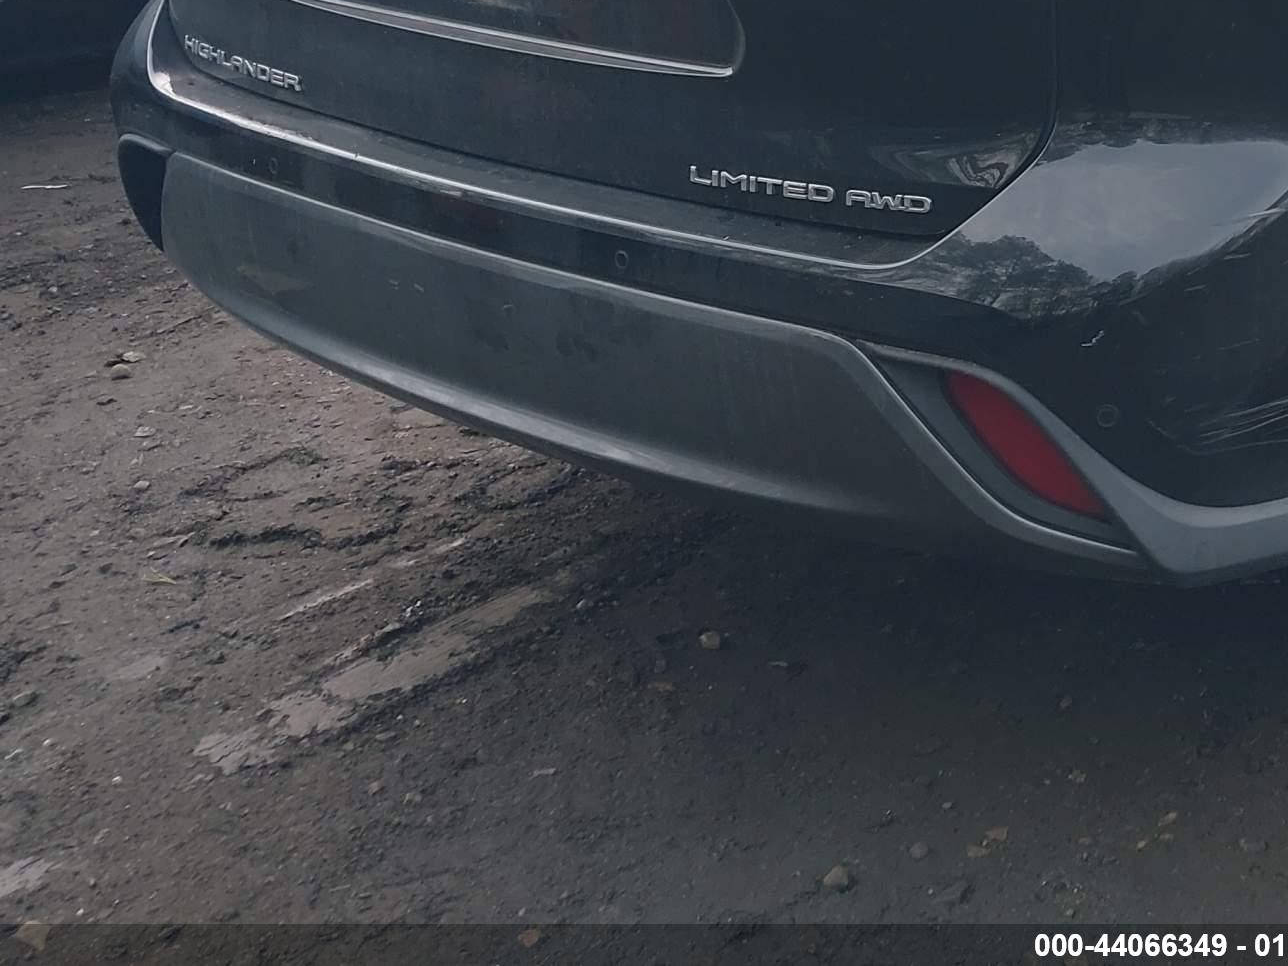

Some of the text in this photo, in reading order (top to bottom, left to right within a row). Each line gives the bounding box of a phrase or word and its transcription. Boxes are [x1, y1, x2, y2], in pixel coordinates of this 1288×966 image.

[184, 34, 301, 92] HIGHLANDER
[689, 165, 933, 214] LIMITED AWD
